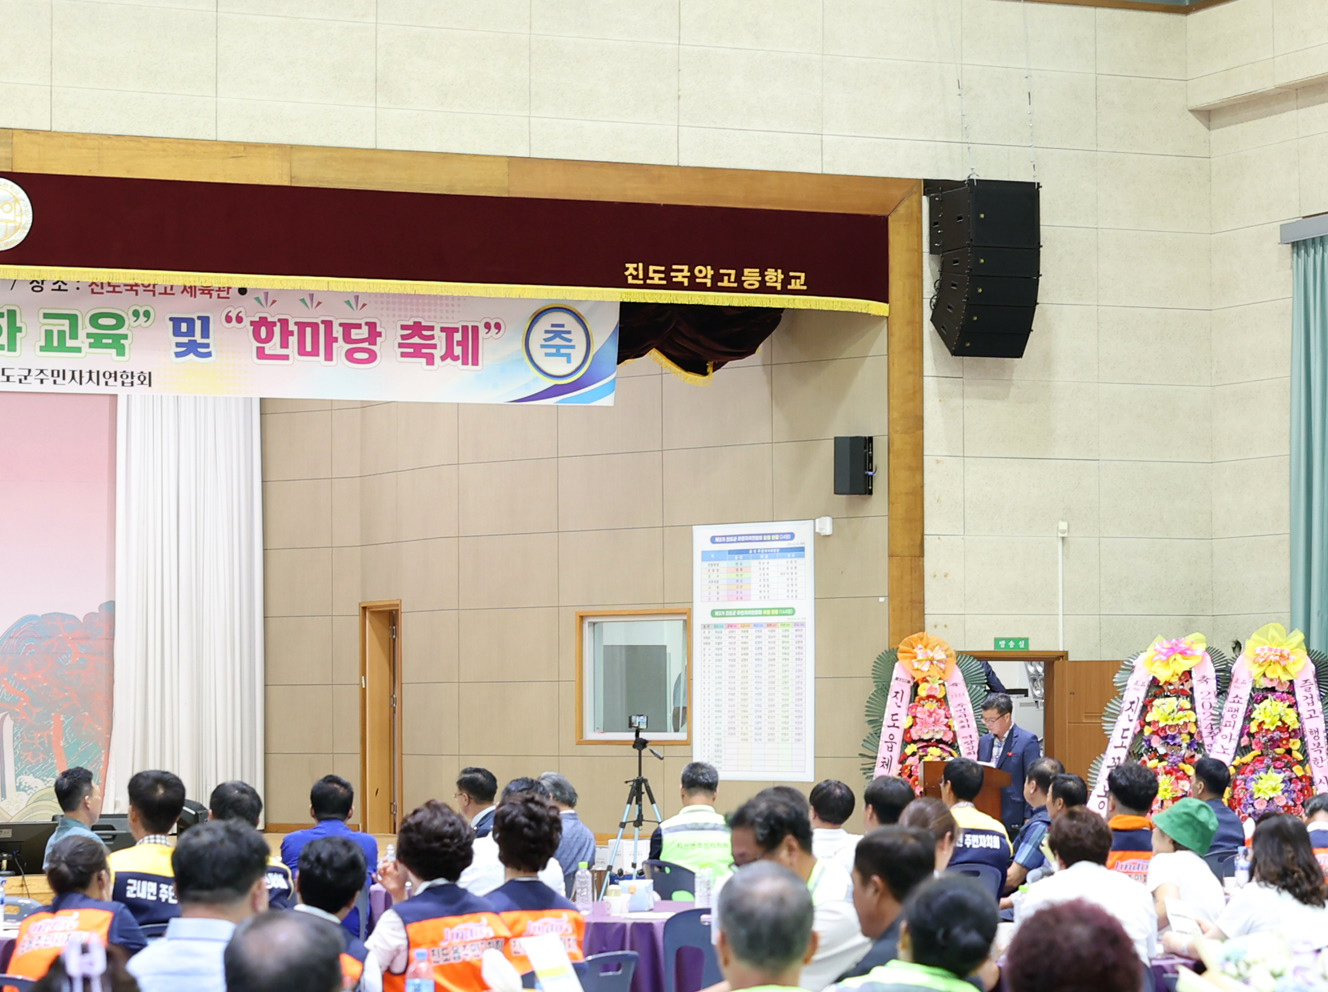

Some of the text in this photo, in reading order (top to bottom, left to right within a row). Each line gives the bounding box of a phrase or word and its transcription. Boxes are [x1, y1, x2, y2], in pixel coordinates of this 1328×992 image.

[623, 262, 808, 290] 진도국악고등학교
[168, 315, 213, 359] 및
[539, 323, 576, 364] 축
[126, 879, 157, 900] 군내면
